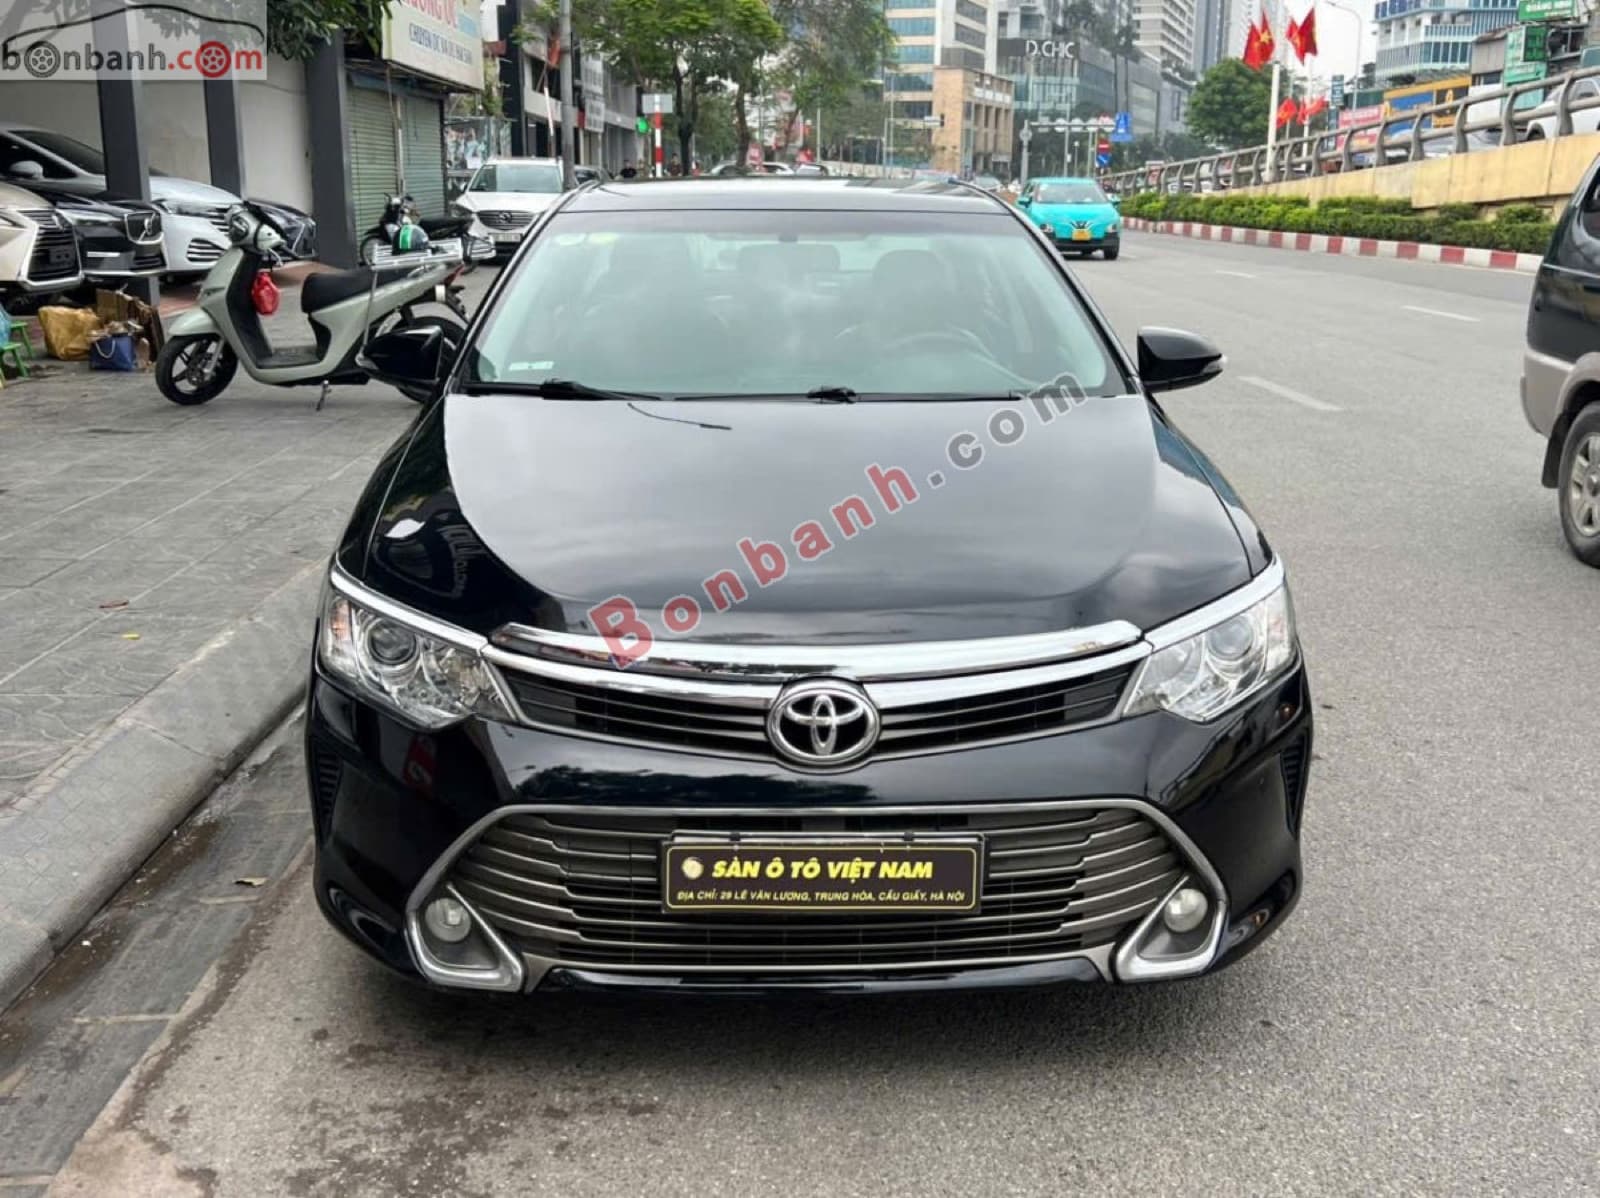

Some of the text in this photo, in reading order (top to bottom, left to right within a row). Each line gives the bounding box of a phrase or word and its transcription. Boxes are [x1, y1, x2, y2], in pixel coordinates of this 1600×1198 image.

[765, 857, 784, 878] Ô
[791, 857, 820, 878] TÔ
[827, 857, 876, 883] VIỆT
[879, 861, 933, 878] NAM
[815, 892, 849, 901] TRUNG
